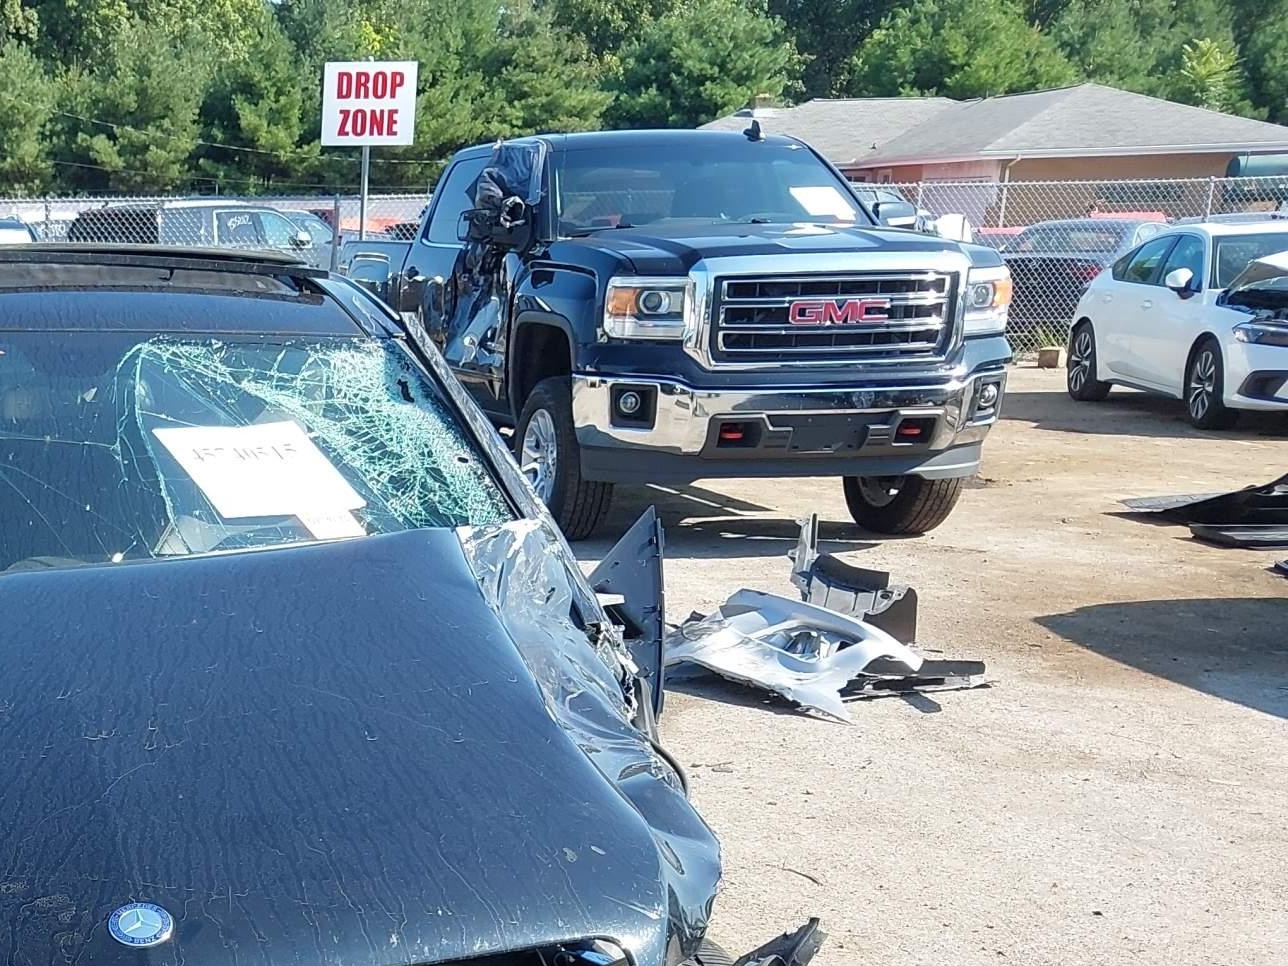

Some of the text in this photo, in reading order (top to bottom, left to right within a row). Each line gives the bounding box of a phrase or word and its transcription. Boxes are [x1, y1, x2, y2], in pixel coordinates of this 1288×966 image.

[336, 71, 405, 99] DROP
[337, 109, 399, 137] ZONE
[789, 299, 890, 325] GMC
